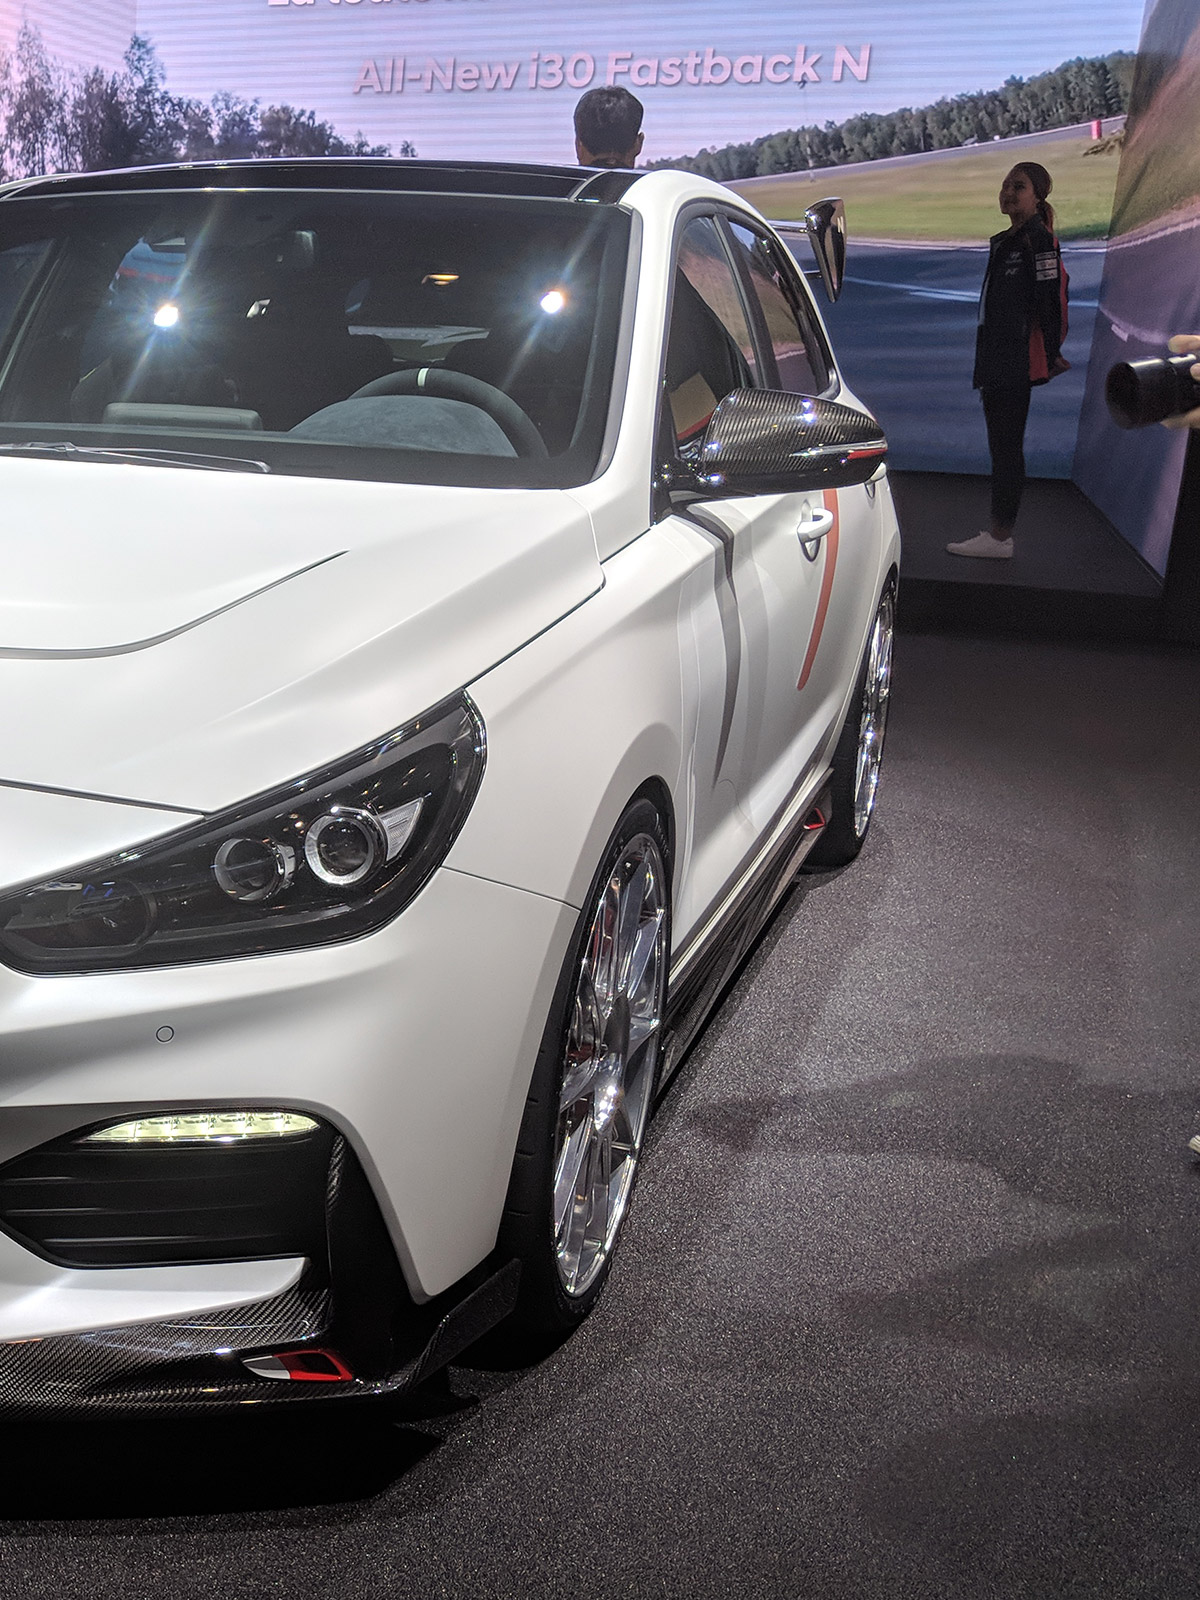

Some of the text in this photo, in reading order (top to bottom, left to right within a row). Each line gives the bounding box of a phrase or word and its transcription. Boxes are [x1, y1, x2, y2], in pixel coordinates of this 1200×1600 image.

[352, 43, 872, 95] All-New i30 Fastback N
